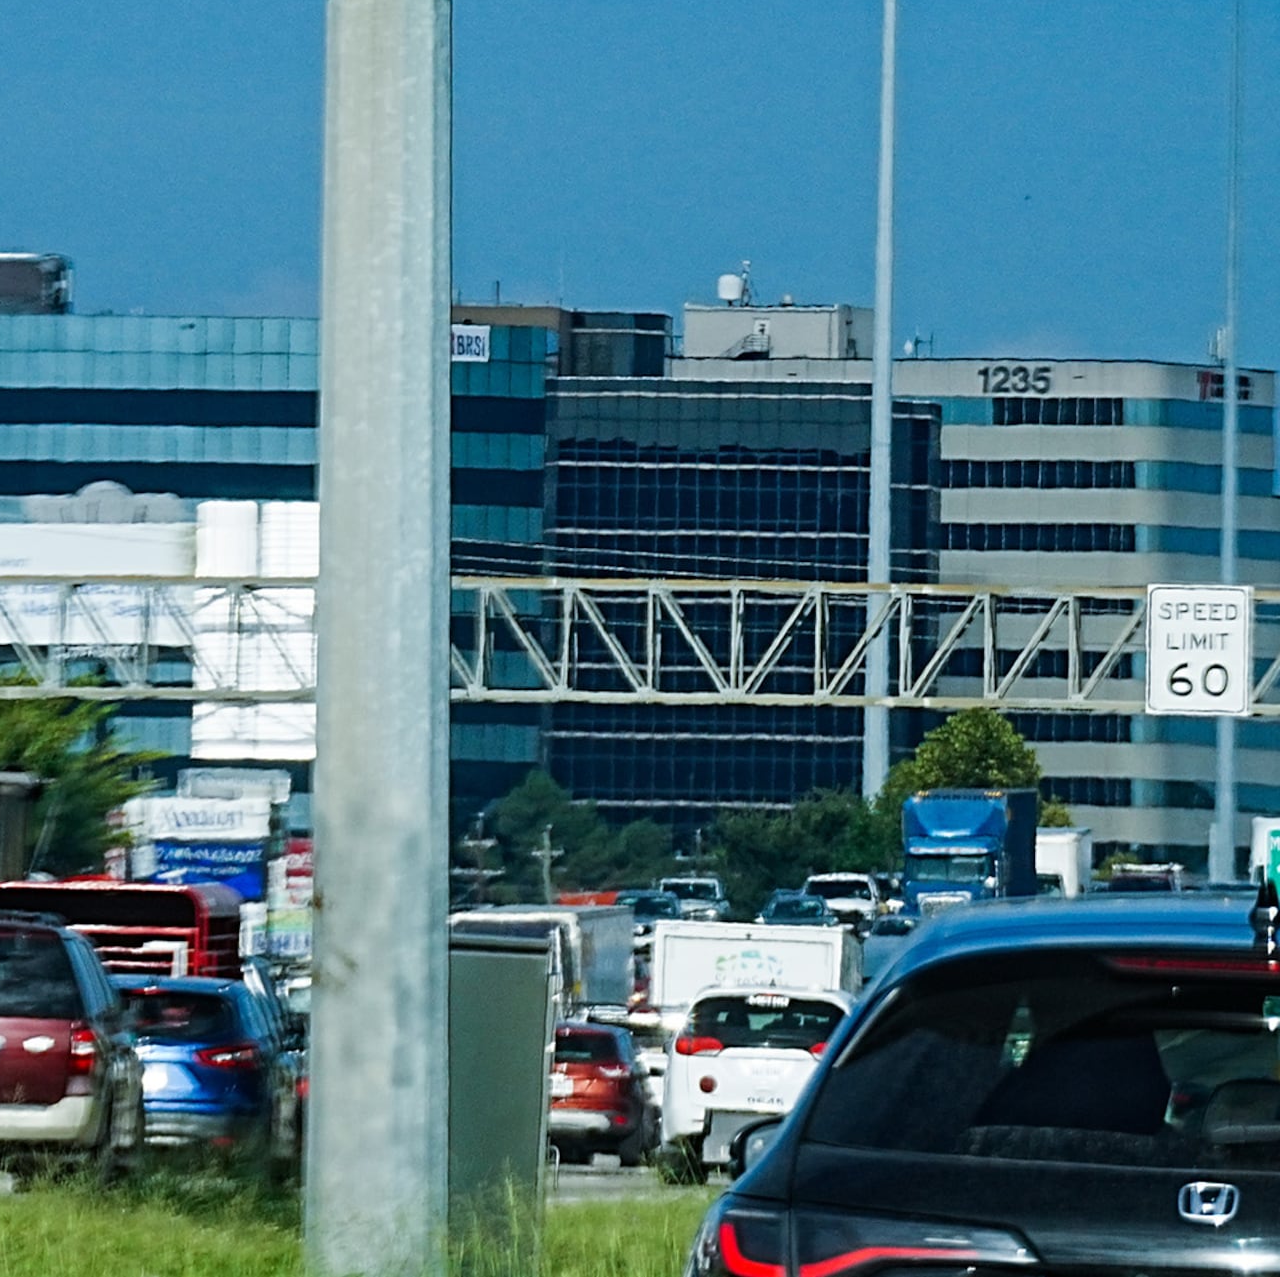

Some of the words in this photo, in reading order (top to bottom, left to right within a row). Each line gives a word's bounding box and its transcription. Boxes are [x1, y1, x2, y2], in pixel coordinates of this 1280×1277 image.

[977, 366, 1052, 394] 1235
[1158, 602, 1239, 621] SPEED
[1166, 632, 1230, 651] LIMIT
[1167, 662, 1229, 697] 60
